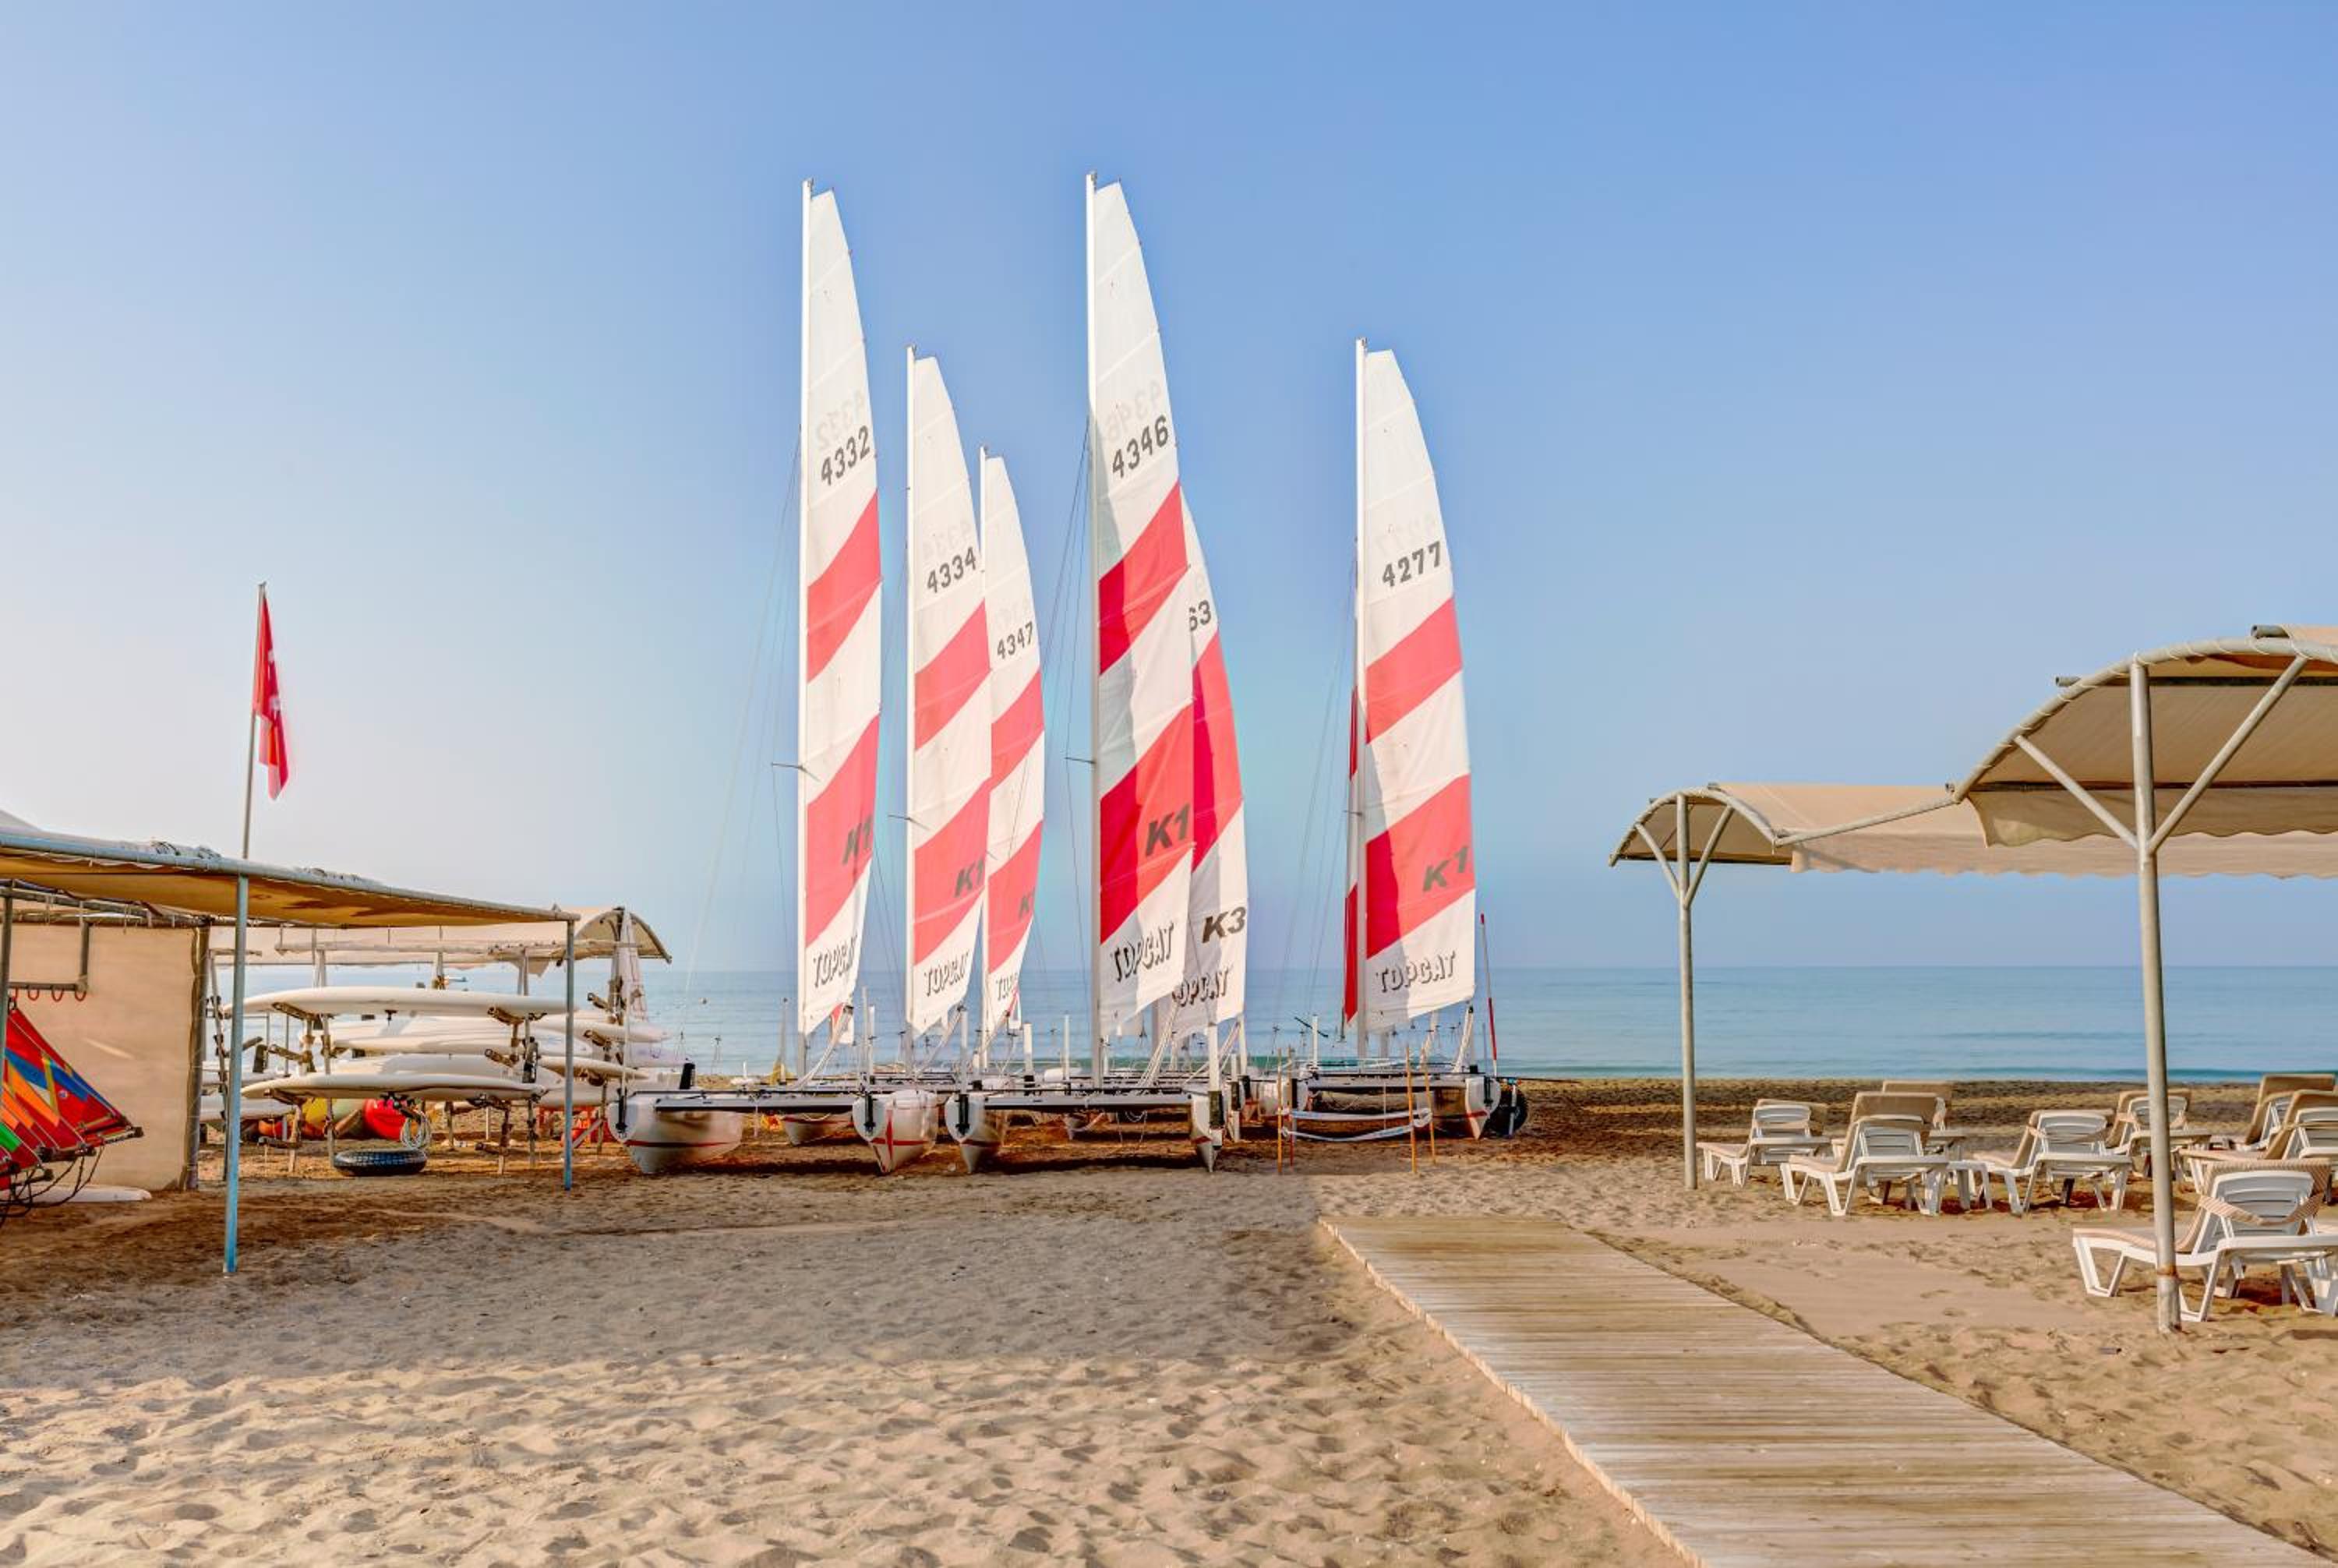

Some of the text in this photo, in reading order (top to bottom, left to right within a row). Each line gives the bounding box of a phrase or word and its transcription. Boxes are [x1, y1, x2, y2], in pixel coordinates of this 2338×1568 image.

[821, 425, 871, 486] 4332
[1112, 414, 1169, 479] 4346
[927, 546, 976, 593] 4334
[1382, 541, 1441, 587] 4277
[997, 620, 1033, 661] 4347
[841, 814, 874, 866] K1
[1145, 803, 1191, 856] K1
[953, 856, 985, 899] K1
[1422, 846, 1469, 892] K1
[1202, 906, 1246, 944] K3
[1110, 920, 1174, 983] TOPCAT
[1376, 951, 1456, 992] TOPCAT
[1171, 967, 1231, 1008] OPCAT
